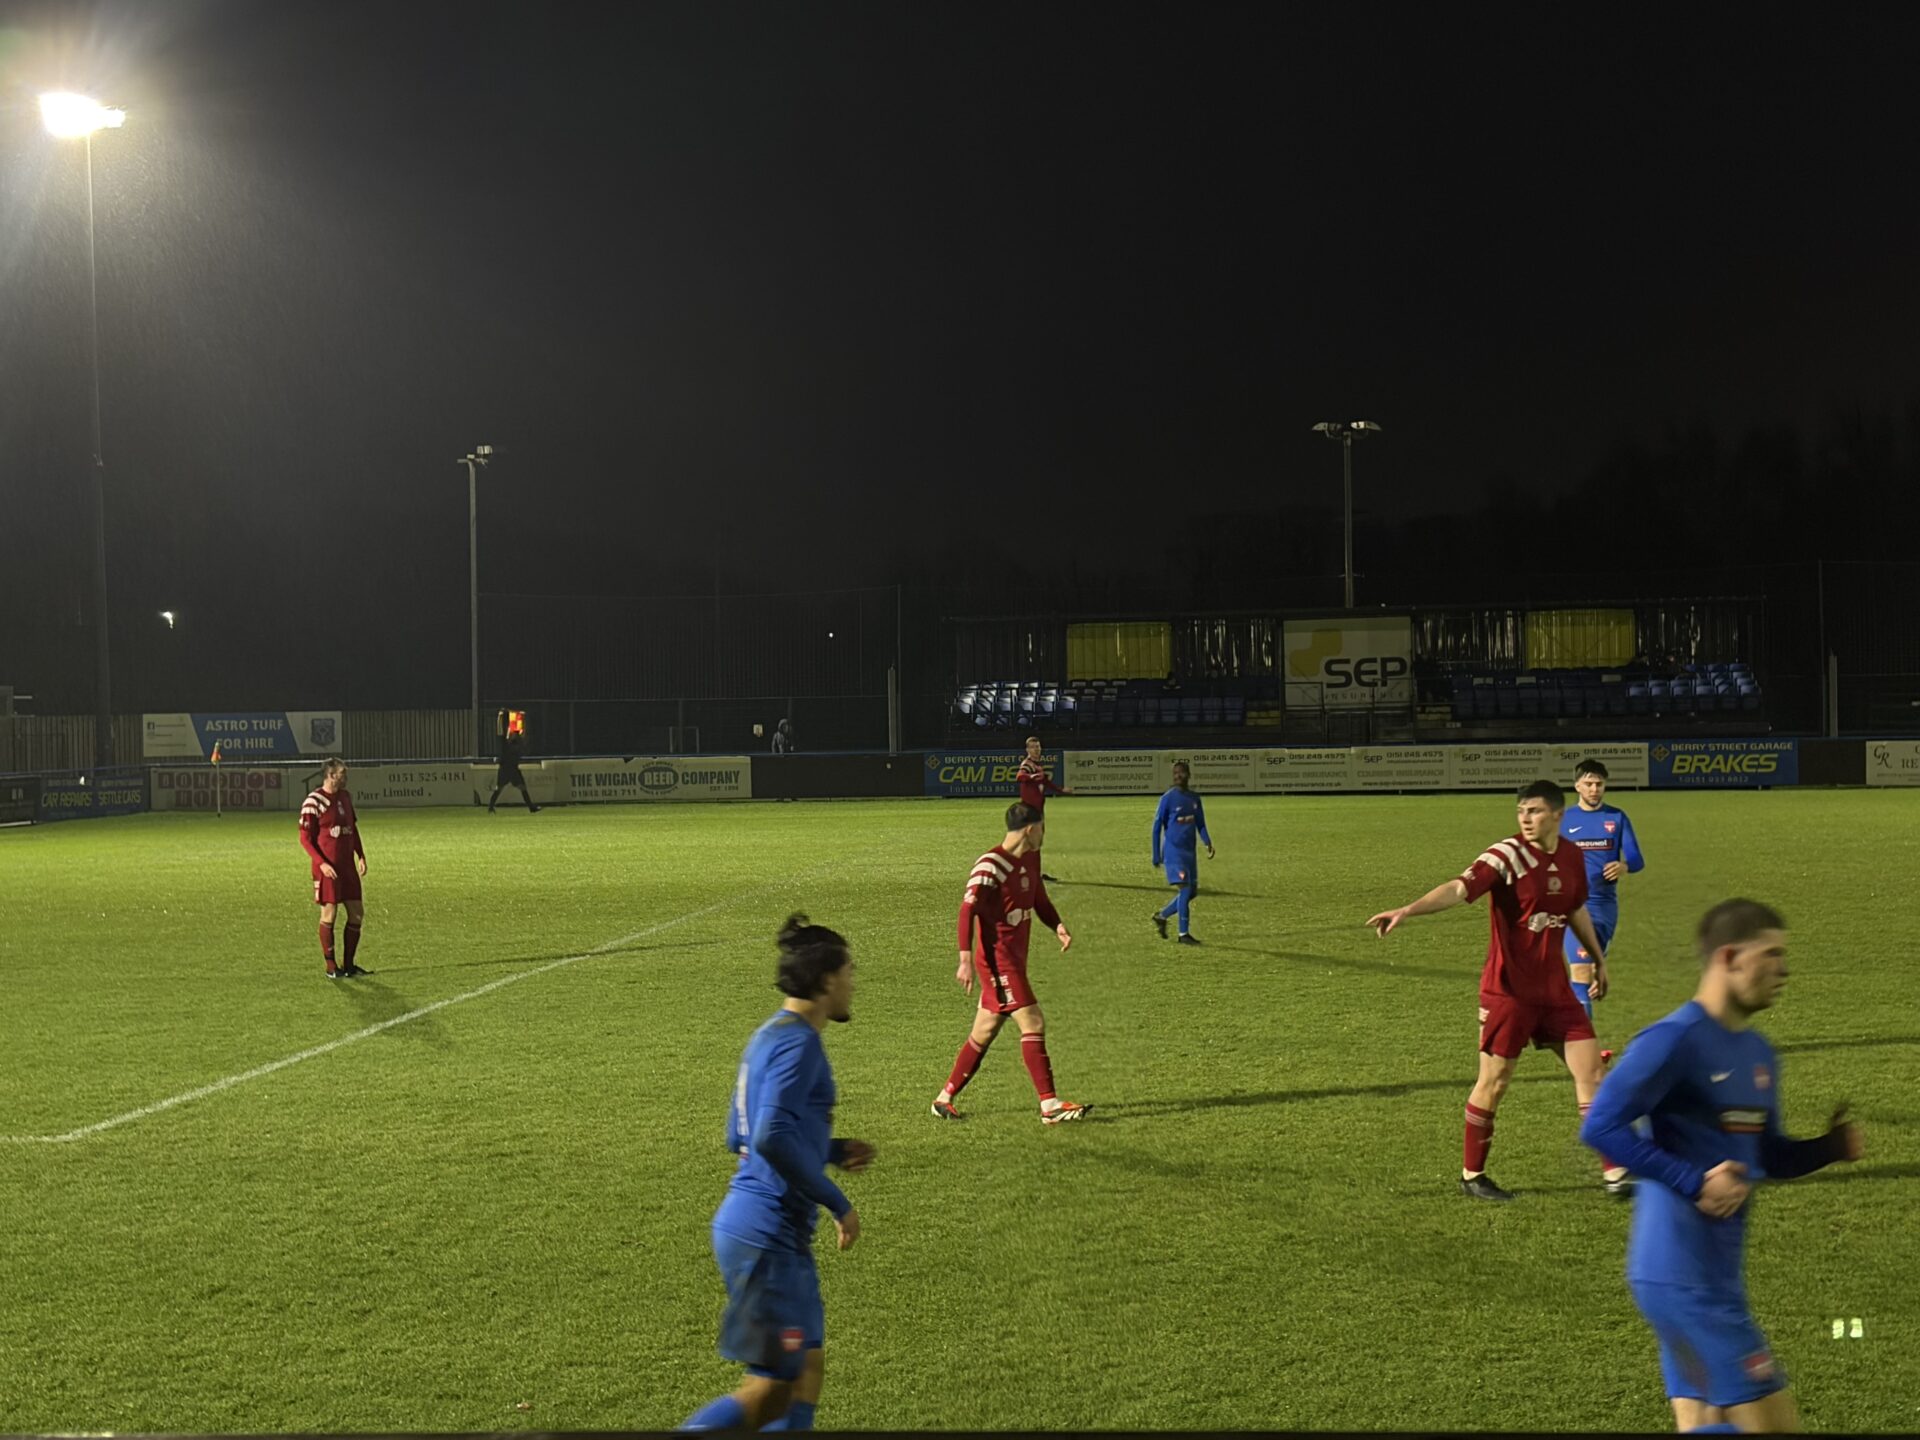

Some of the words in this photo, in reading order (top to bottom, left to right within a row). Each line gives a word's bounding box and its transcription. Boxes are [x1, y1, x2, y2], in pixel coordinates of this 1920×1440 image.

[1324, 656, 1407, 688] SEP
[205, 719, 247, 732] ASTRO
[250, 718, 285, 731] TURF
[245, 737, 273, 749] HIRE
[1671, 743, 1706, 751] BERRY
[1708, 743, 1747, 751] STREET
[1750, 742, 1793, 750] GARAGE
[944, 755, 976, 764] BERRY
[978, 754, 1016, 763] STREET
[1266, 757, 1286, 765] SEP
[1363, 755, 1383, 764] SEP
[1461, 753, 1481, 762] SEP
[1559, 751, 1580, 761] SEP
[1074, 759, 1095, 768] SEP
[1671, 753, 1779, 774] BRAKES
[387, 773, 414, 783] 0151
[418, 772, 437, 782] 525
[440, 771, 466, 781] 4181
[569, 773, 593, 788] THE
[594, 772, 637, 787] WIGAN
[643, 770, 675, 786] BEER
[681, 769, 740, 785] COMPANY
[938, 765, 987, 784] CAM
[1100, 772, 1154, 781] INSURANCE
[41, 791, 59, 808] CAR
[122, 789, 142, 805] CARS
[356, 790, 379, 801] Parr
[383, 787, 424, 798] Limited
